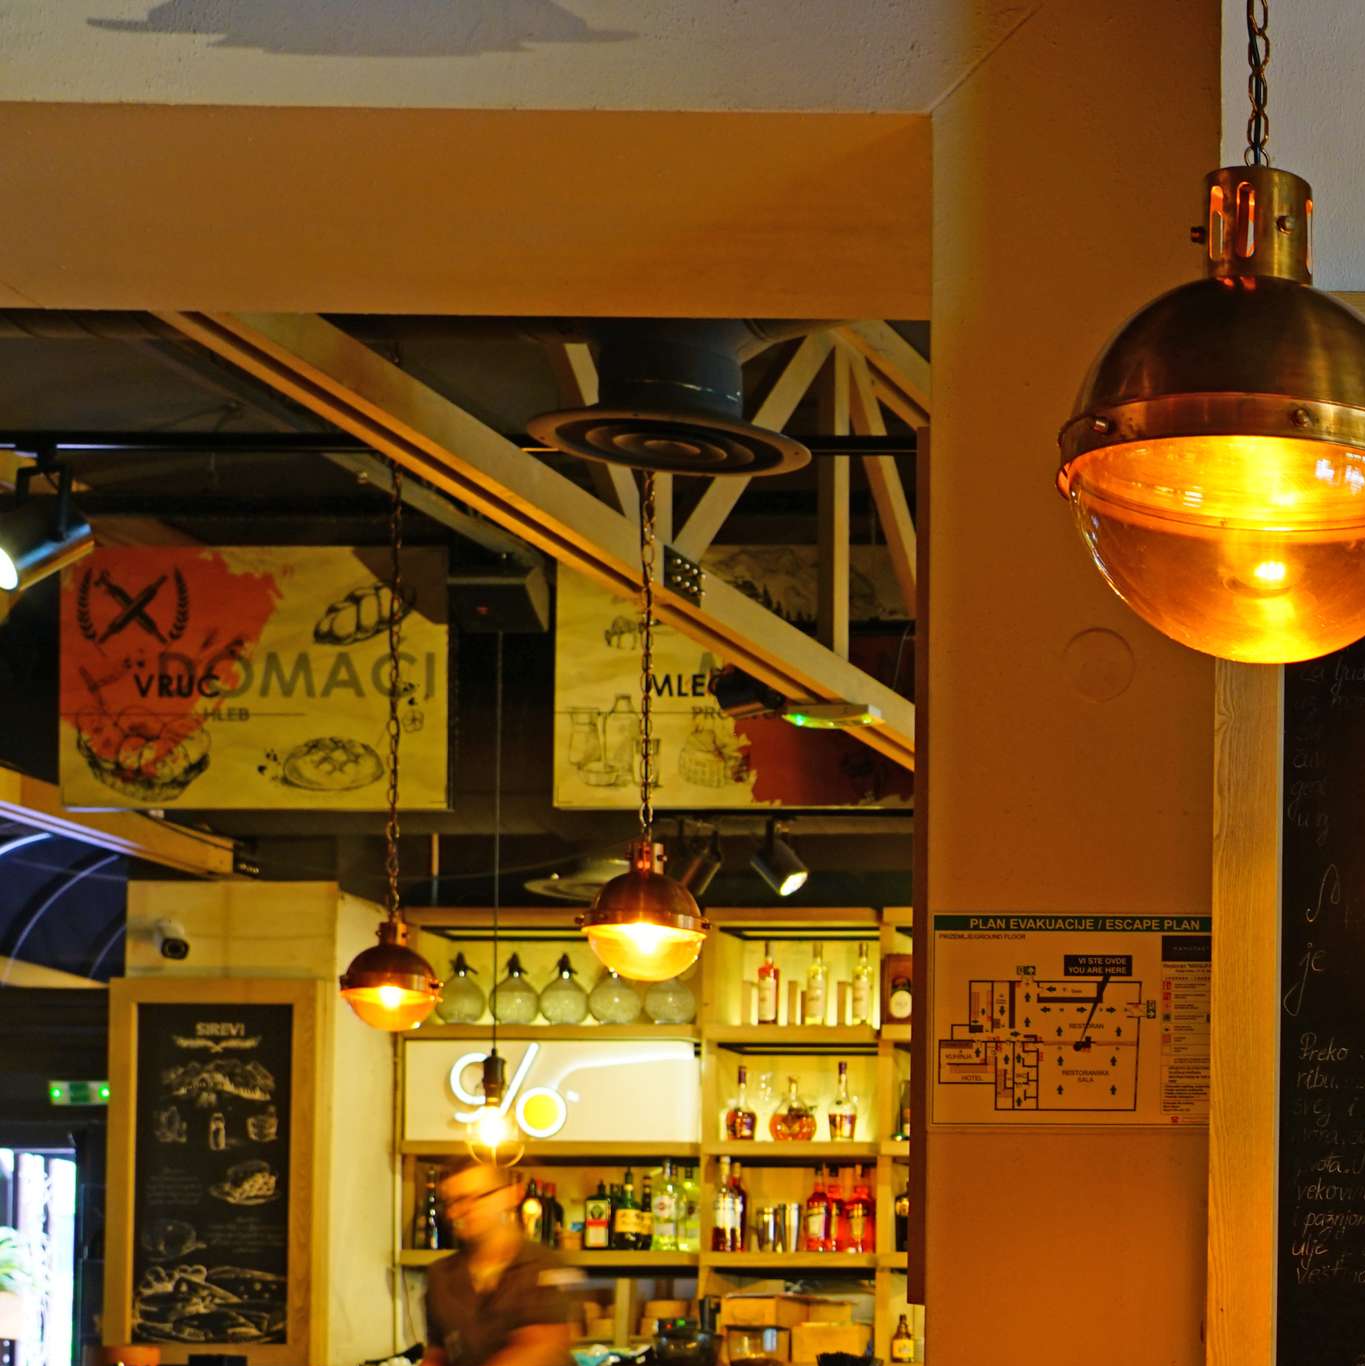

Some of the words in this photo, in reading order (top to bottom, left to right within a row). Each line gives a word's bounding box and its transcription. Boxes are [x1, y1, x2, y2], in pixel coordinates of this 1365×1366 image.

[203, 708, 250, 722] HLEB
[970, 918, 1006, 930] PLAN
[1010, 918, 1094, 930] EVAKUACIJE
[1105, 919, 1160, 931] ESCAPE
[1164, 919, 1200, 931] PLAN
[1068, 966, 1084, 974] YOU
[1086, 966, 1103, 974] ARE
[1105, 966, 1127, 974] HERE
[195, 1022, 245, 1036] SIREVI
